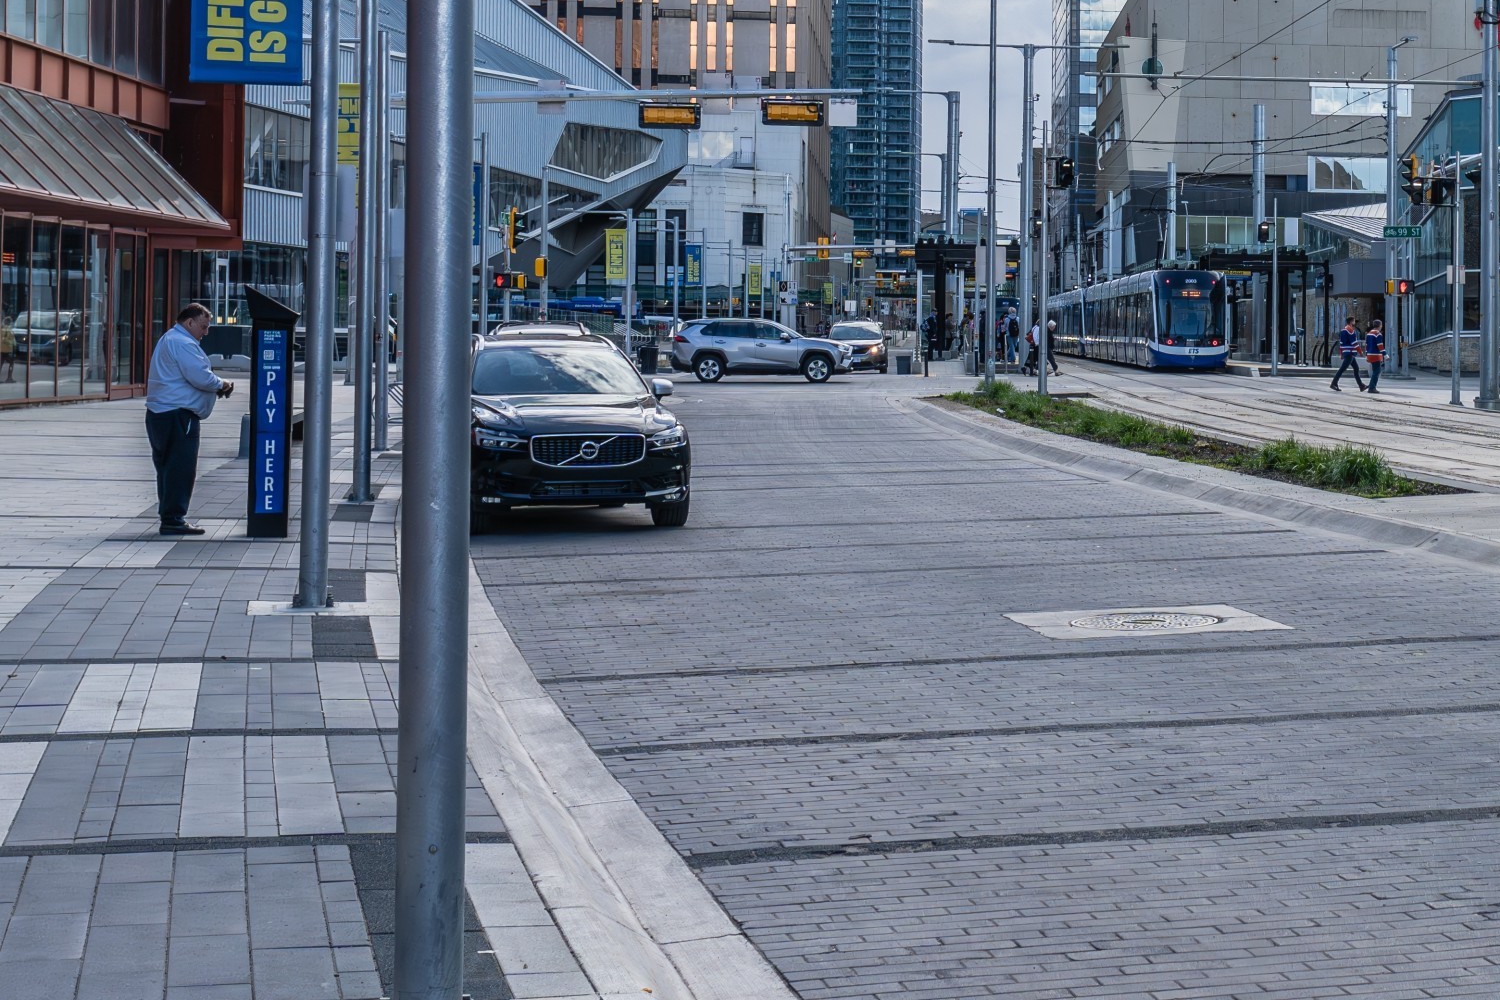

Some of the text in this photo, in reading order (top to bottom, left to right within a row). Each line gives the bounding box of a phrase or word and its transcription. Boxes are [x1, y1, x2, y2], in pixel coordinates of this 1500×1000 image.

[249, 30, 287, 63] IS
[1397, 227, 1420, 236] 99 ST
[265, 371, 277, 423] PAY
[264, 439, 275, 510] HERE
